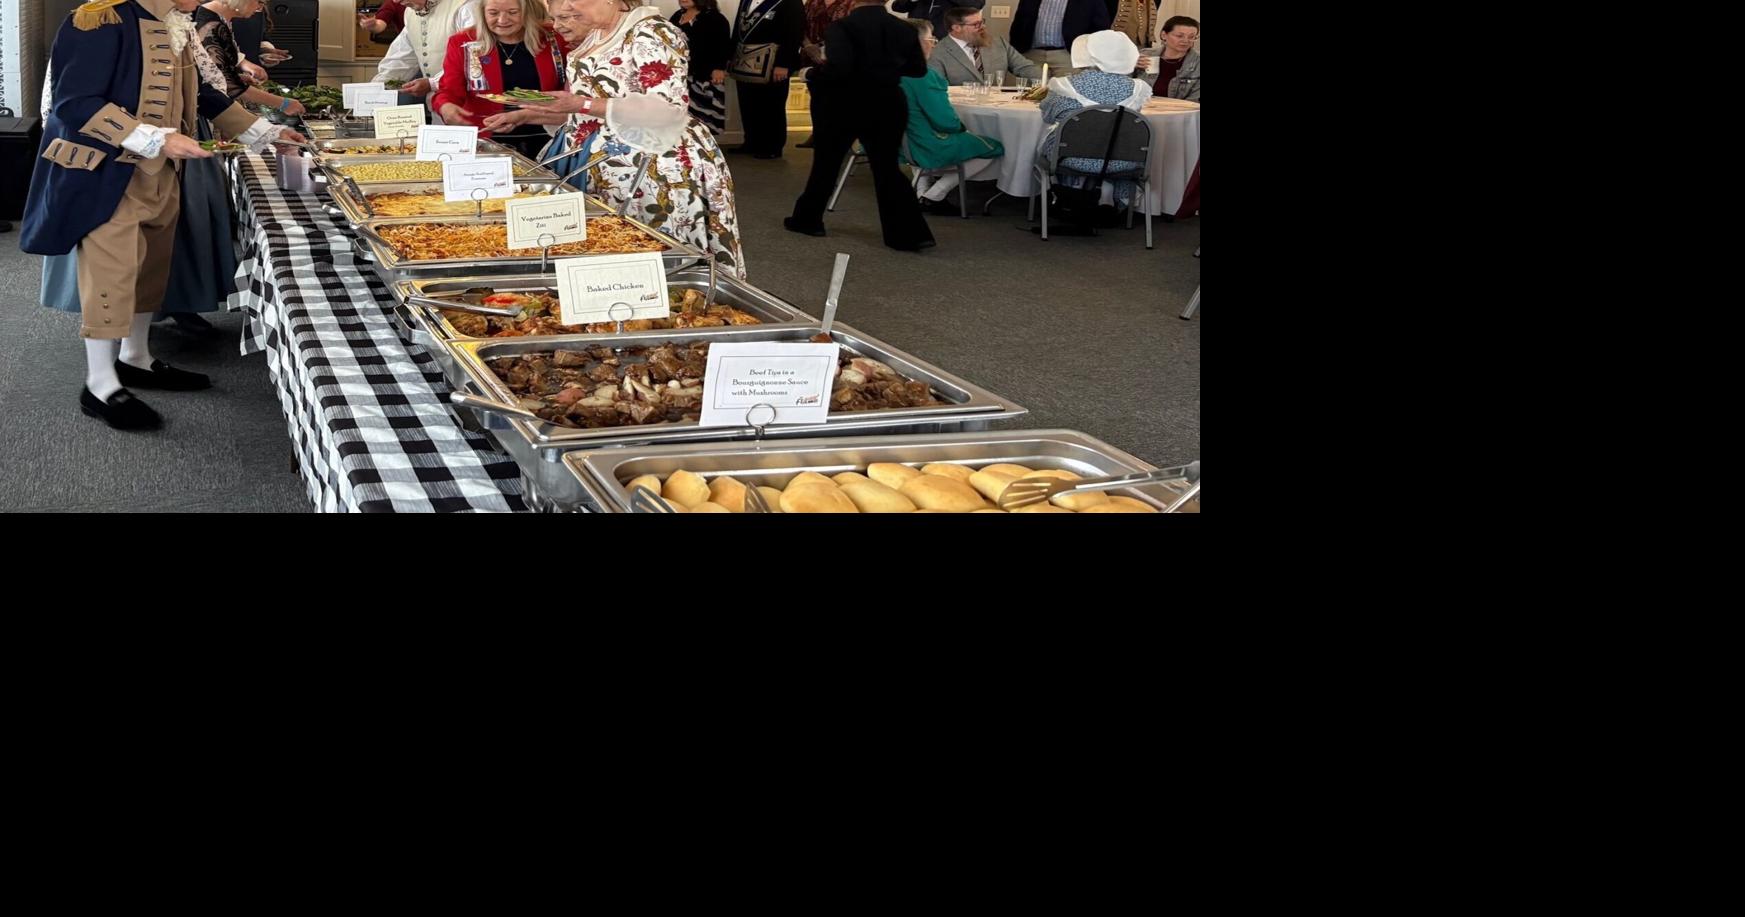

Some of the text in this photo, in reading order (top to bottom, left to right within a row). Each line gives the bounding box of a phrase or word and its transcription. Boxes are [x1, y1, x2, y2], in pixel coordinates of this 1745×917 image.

[521, 215, 552, 223] Vegetarian
[587, 283, 644, 293] Baked Chicken
[749, 368, 766, 376] Beef
[767, 369, 781, 377] Tips
[731, 388, 788, 396] with Mushrooms
